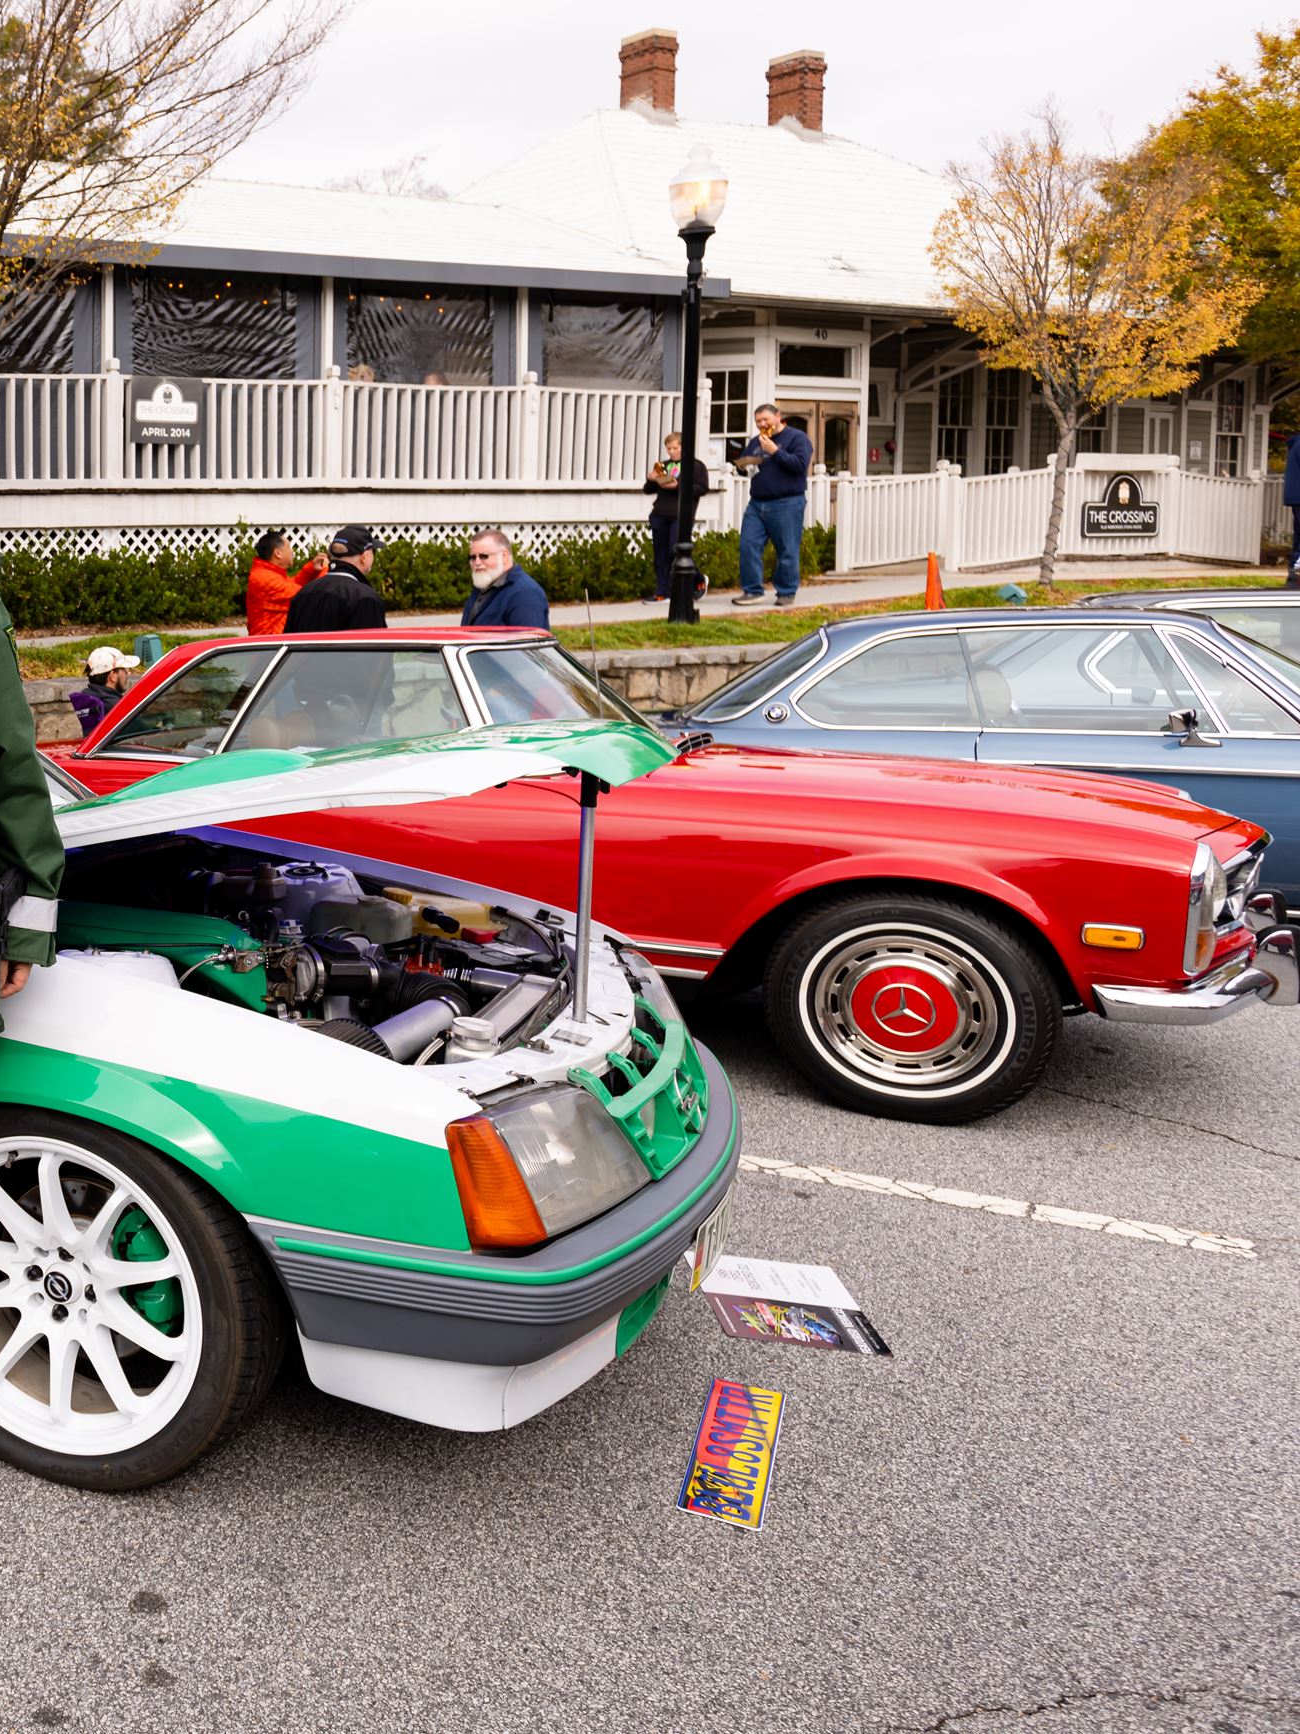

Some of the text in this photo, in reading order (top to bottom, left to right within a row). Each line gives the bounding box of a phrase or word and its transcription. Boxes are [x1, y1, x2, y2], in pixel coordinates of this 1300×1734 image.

[814, 327, 828, 341] 40
[141, 427, 191, 438] APRIL 2014
[1088, 510, 1155, 524] THE CROSSING
